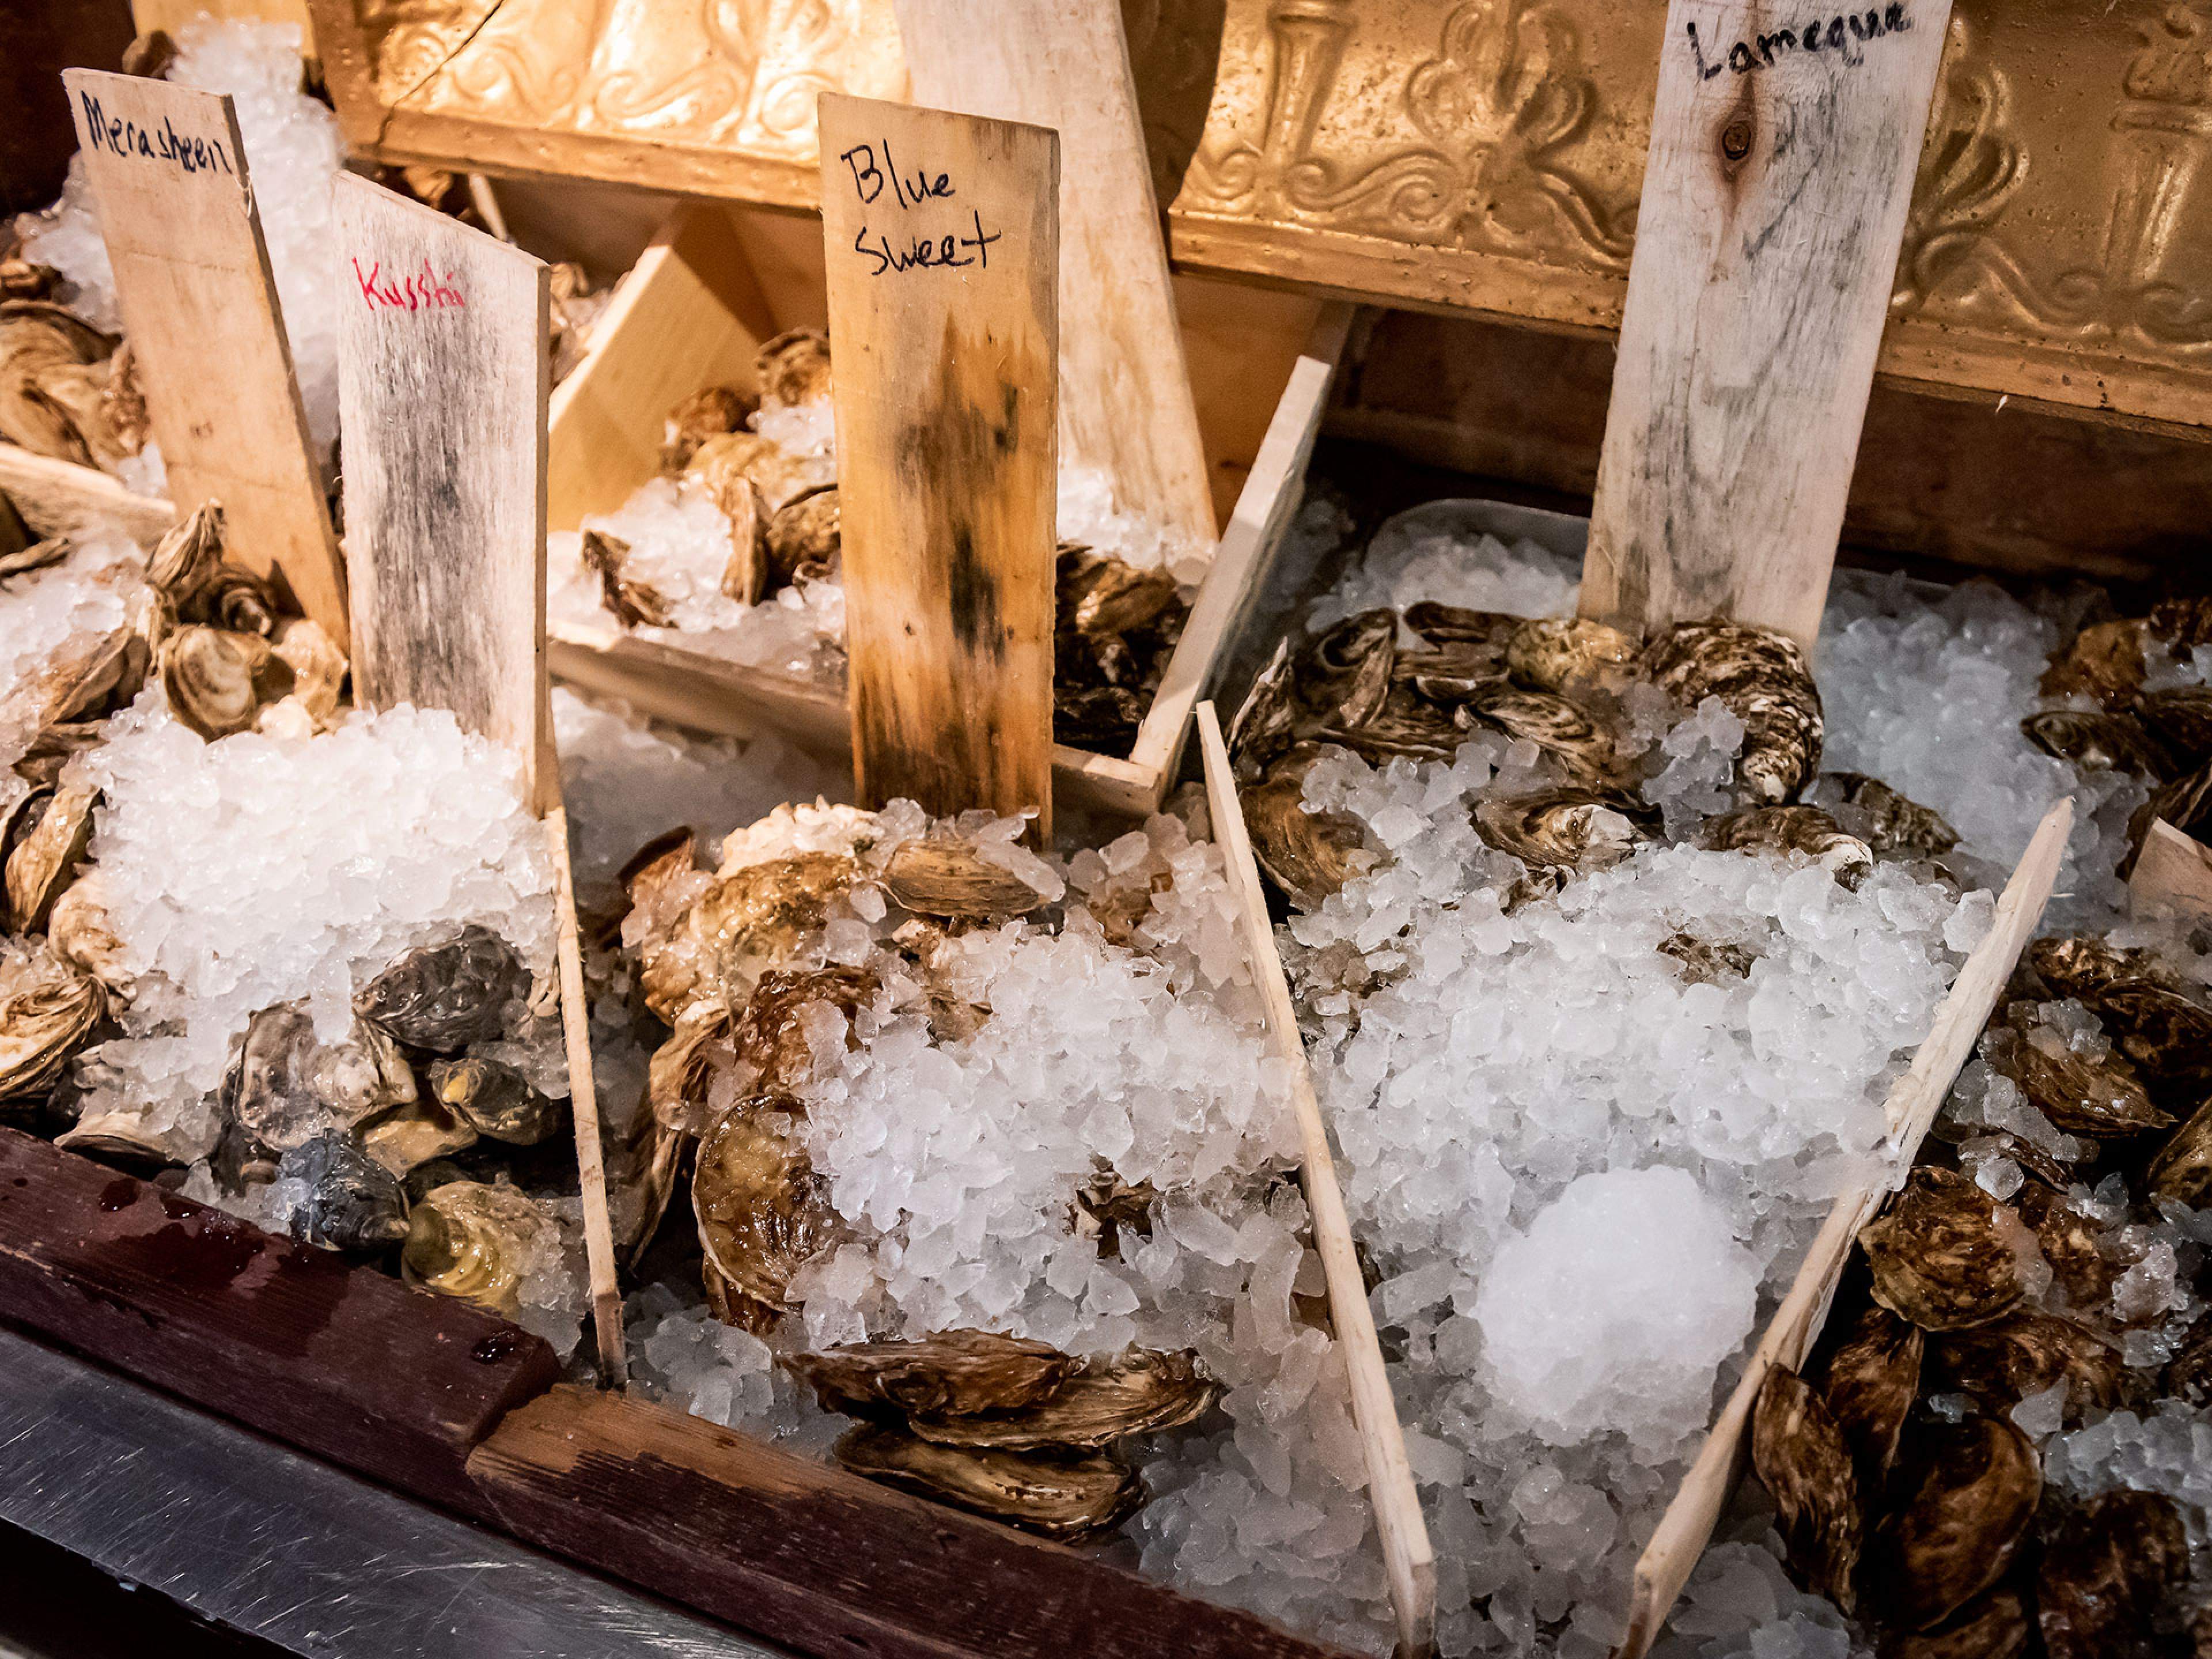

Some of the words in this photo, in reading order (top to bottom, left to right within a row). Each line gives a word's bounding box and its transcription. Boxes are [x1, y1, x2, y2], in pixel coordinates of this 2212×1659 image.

[840, 138, 956, 210] Blue
[855, 209, 1002, 276] Sweet
[352, 257, 464, 310] Kusshi
